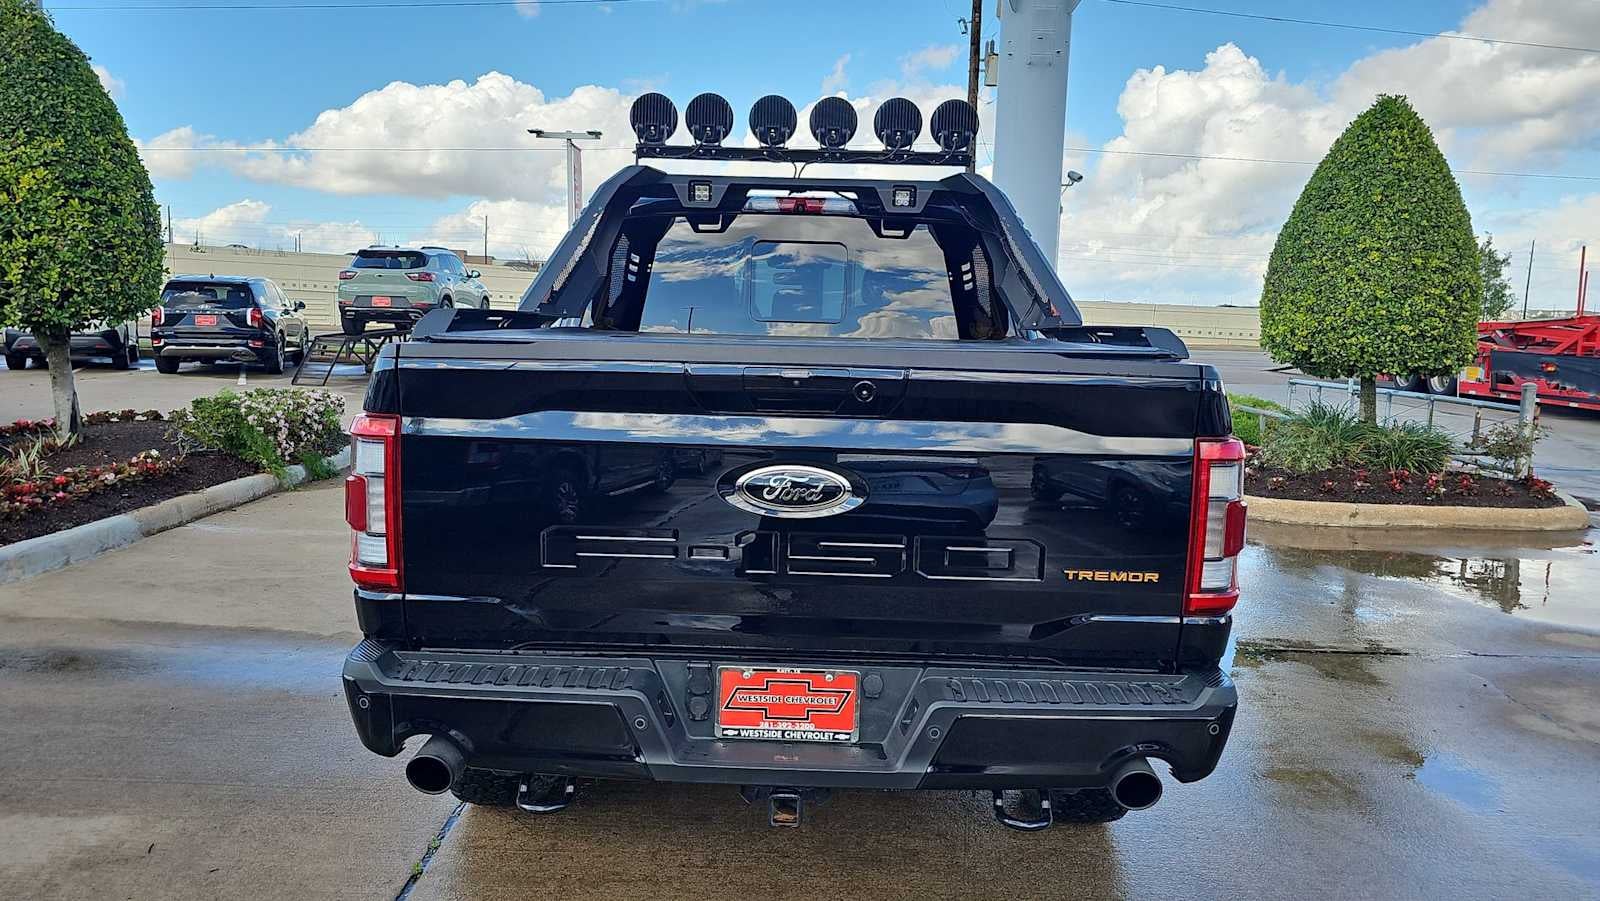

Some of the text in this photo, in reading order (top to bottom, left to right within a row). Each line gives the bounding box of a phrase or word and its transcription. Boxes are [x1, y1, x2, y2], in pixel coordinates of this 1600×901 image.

[763, 474, 825, 501] Ford
[539, 525, 1046, 582] F-150
[1064, 569, 1160, 583] TREMOR
[735, 694, 839, 705] WESTSIDE CHEVROLET
[740, 729, 834, 741] WESTSIDE CHEVROLET
